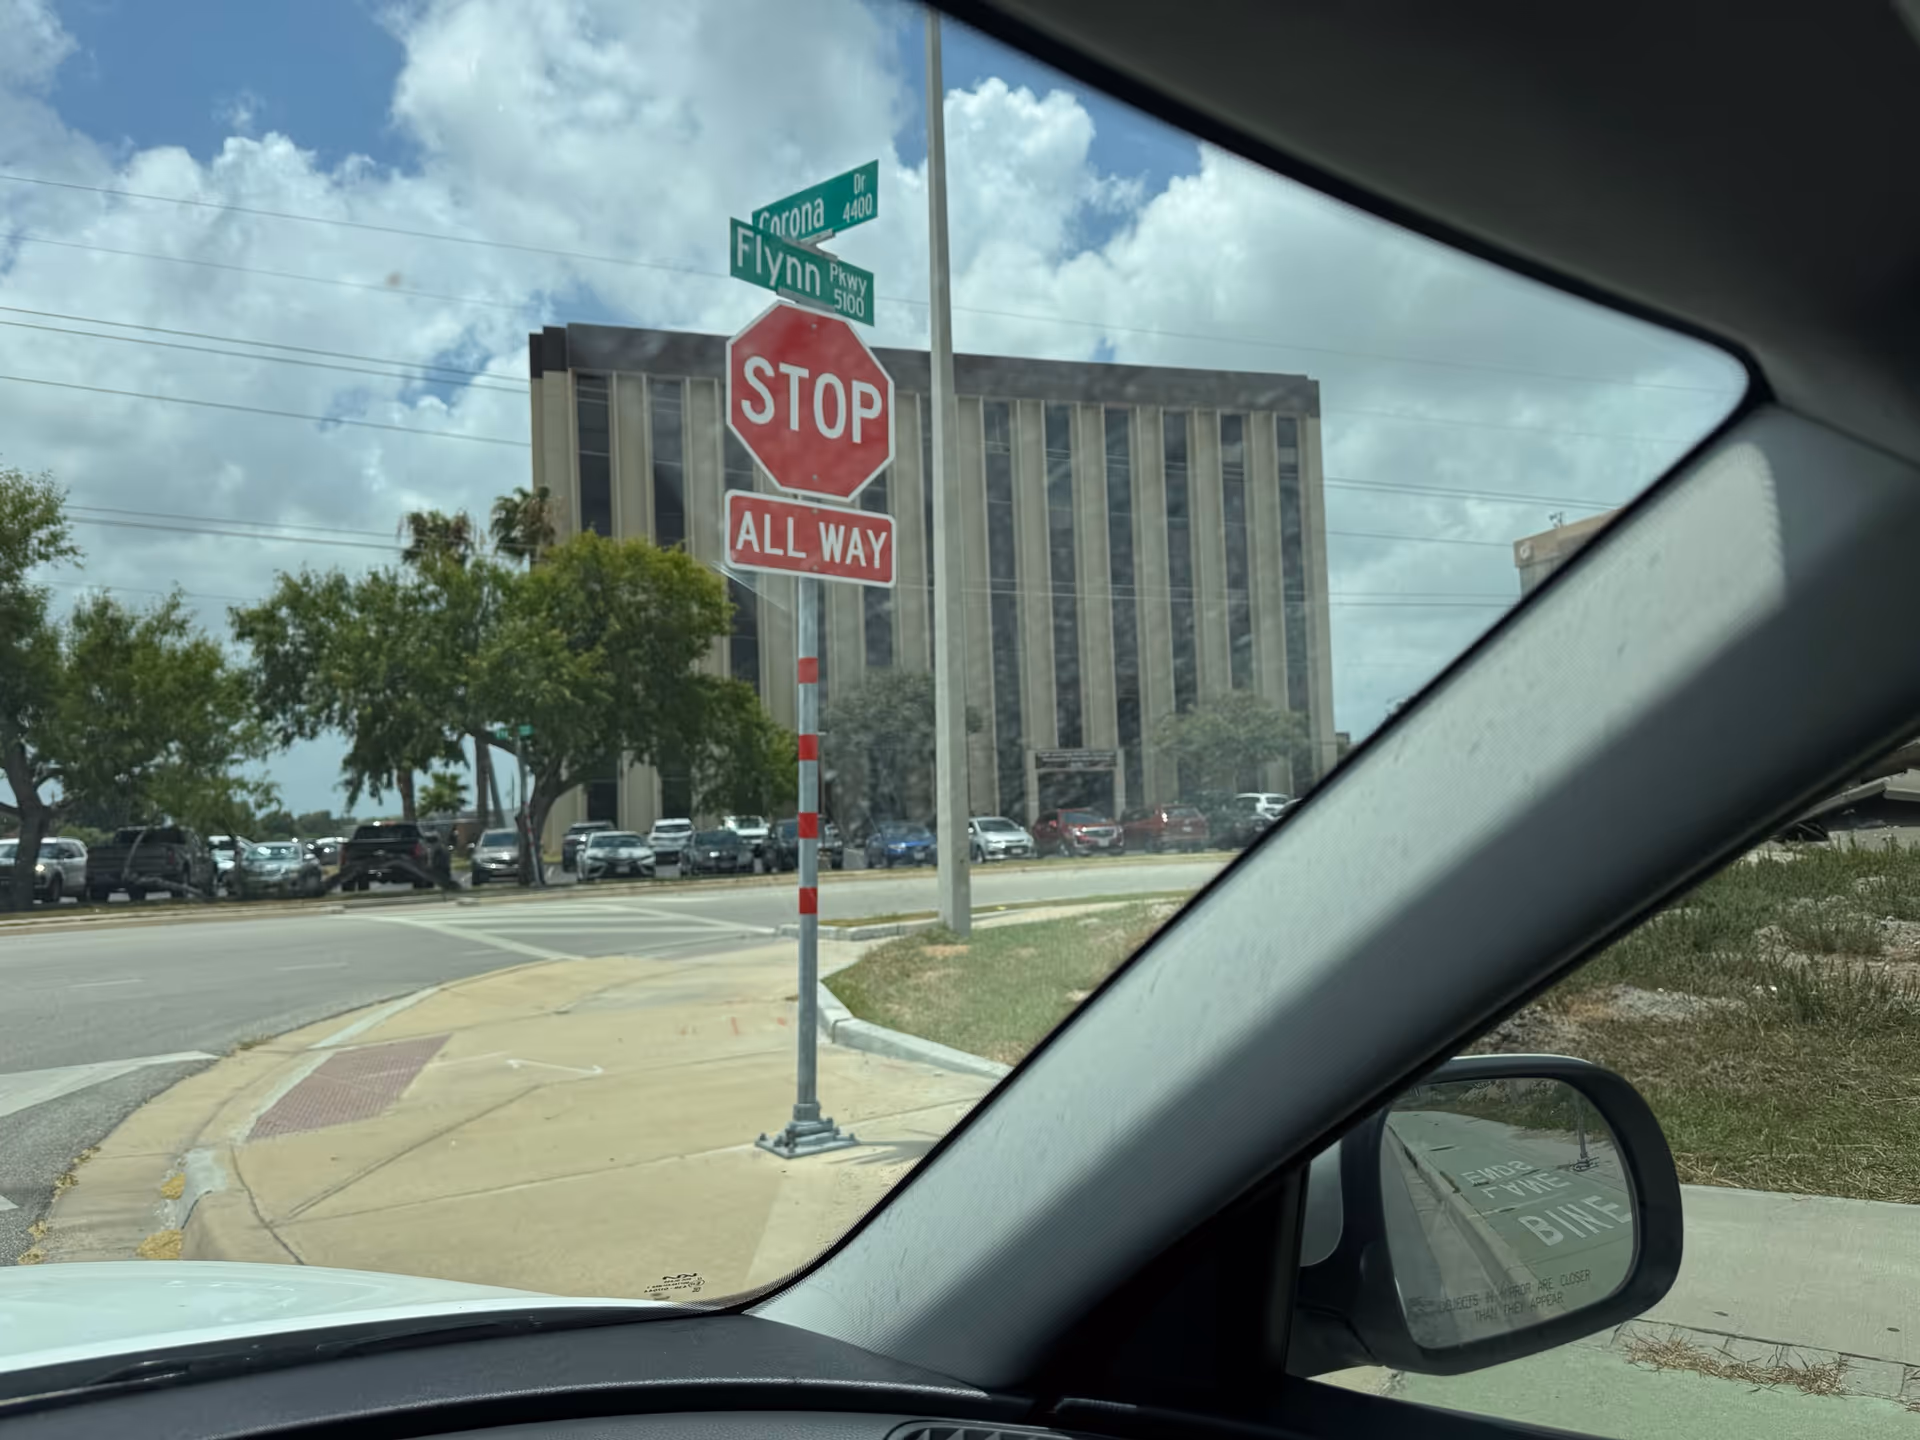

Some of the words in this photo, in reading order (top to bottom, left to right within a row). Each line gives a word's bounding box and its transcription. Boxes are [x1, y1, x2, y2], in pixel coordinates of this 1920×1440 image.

[758, 197, 824, 237] Corona
[853, 173, 866, 194] Dr
[843, 193, 872, 223] 4400
[737, 226, 820, 296] Flynn
[830, 262, 867, 297] Pkwy
[834, 289, 864, 317] 5100
[741, 356, 882, 444] STOP
[736, 511, 807, 558] ALL
[819, 521, 887, 569] WAY
[1530, 1292, 1564, 1309] APPEAR
[1537, 1276, 1553, 1291] ARE
[1560, 1269, 1591, 1287] CLOSER
